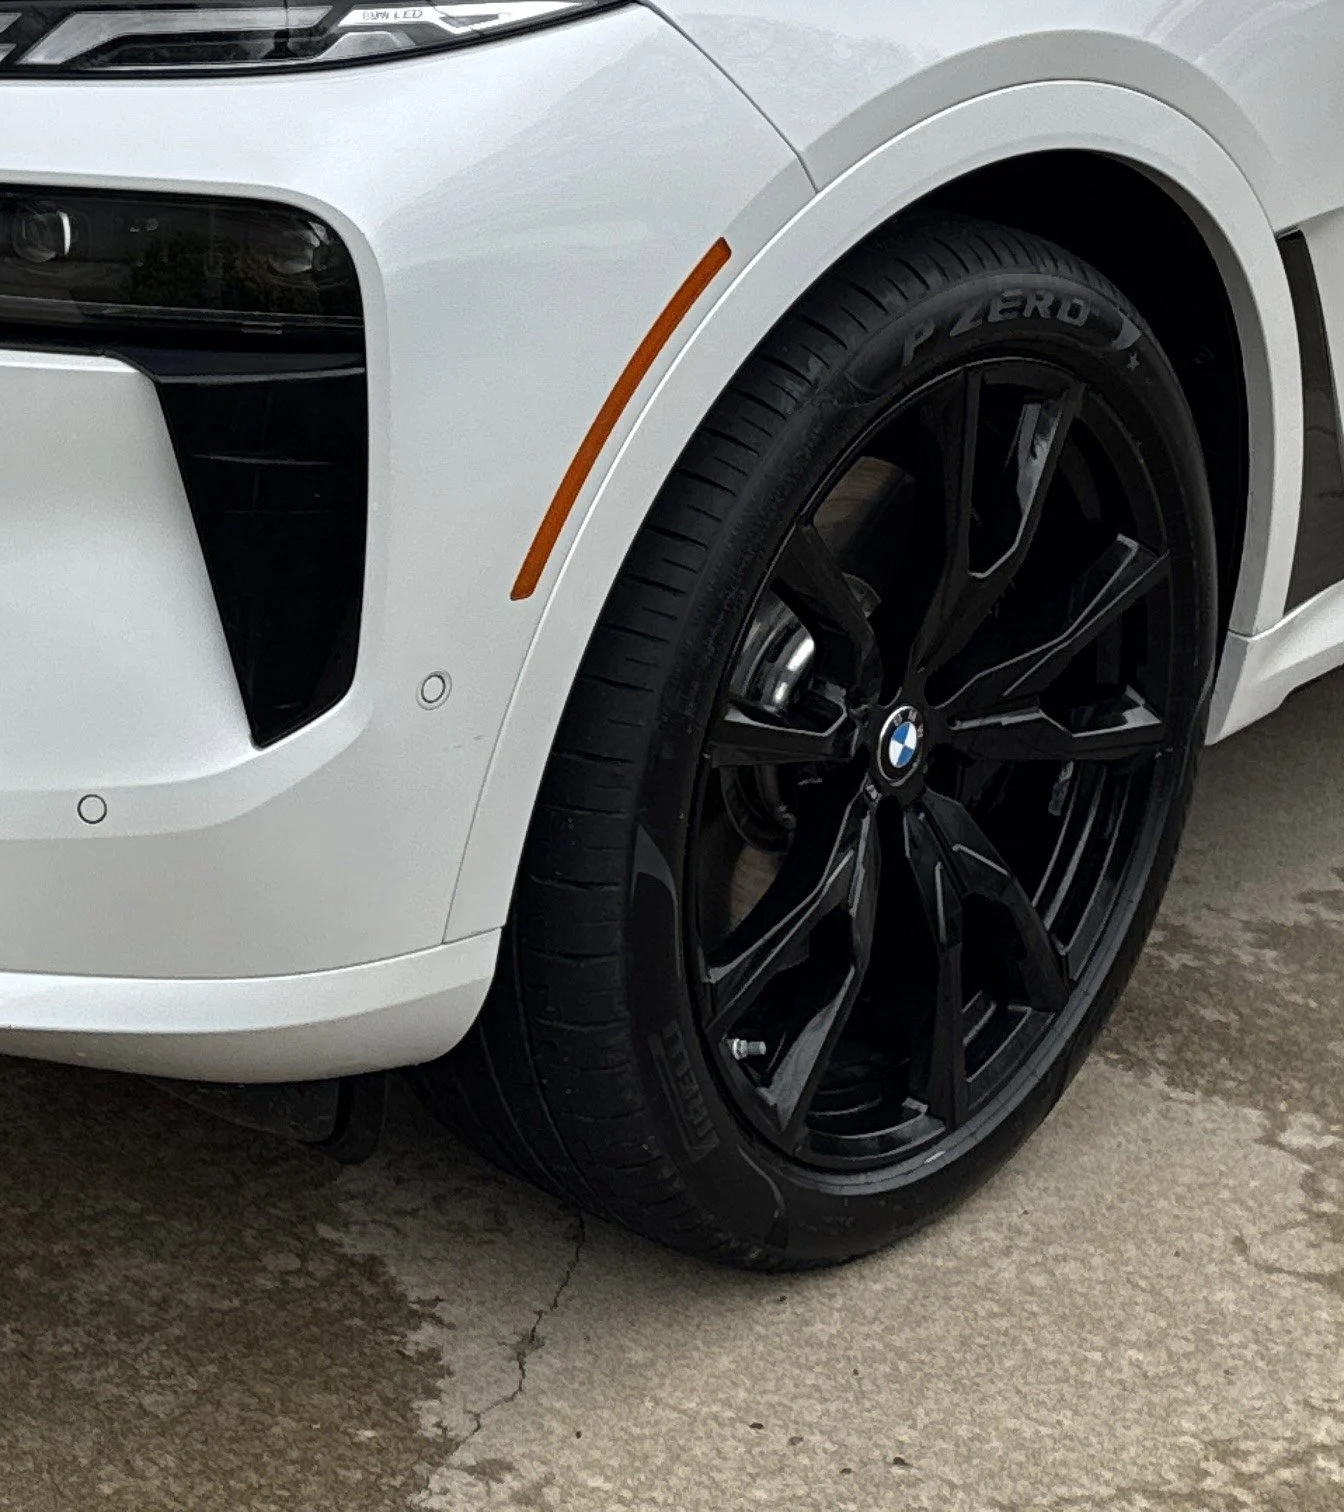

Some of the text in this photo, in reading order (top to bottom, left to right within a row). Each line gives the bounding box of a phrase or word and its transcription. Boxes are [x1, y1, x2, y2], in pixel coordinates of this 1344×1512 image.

[394, 9, 423, 19] LED
[904, 288, 1092, 366] P ZERO
